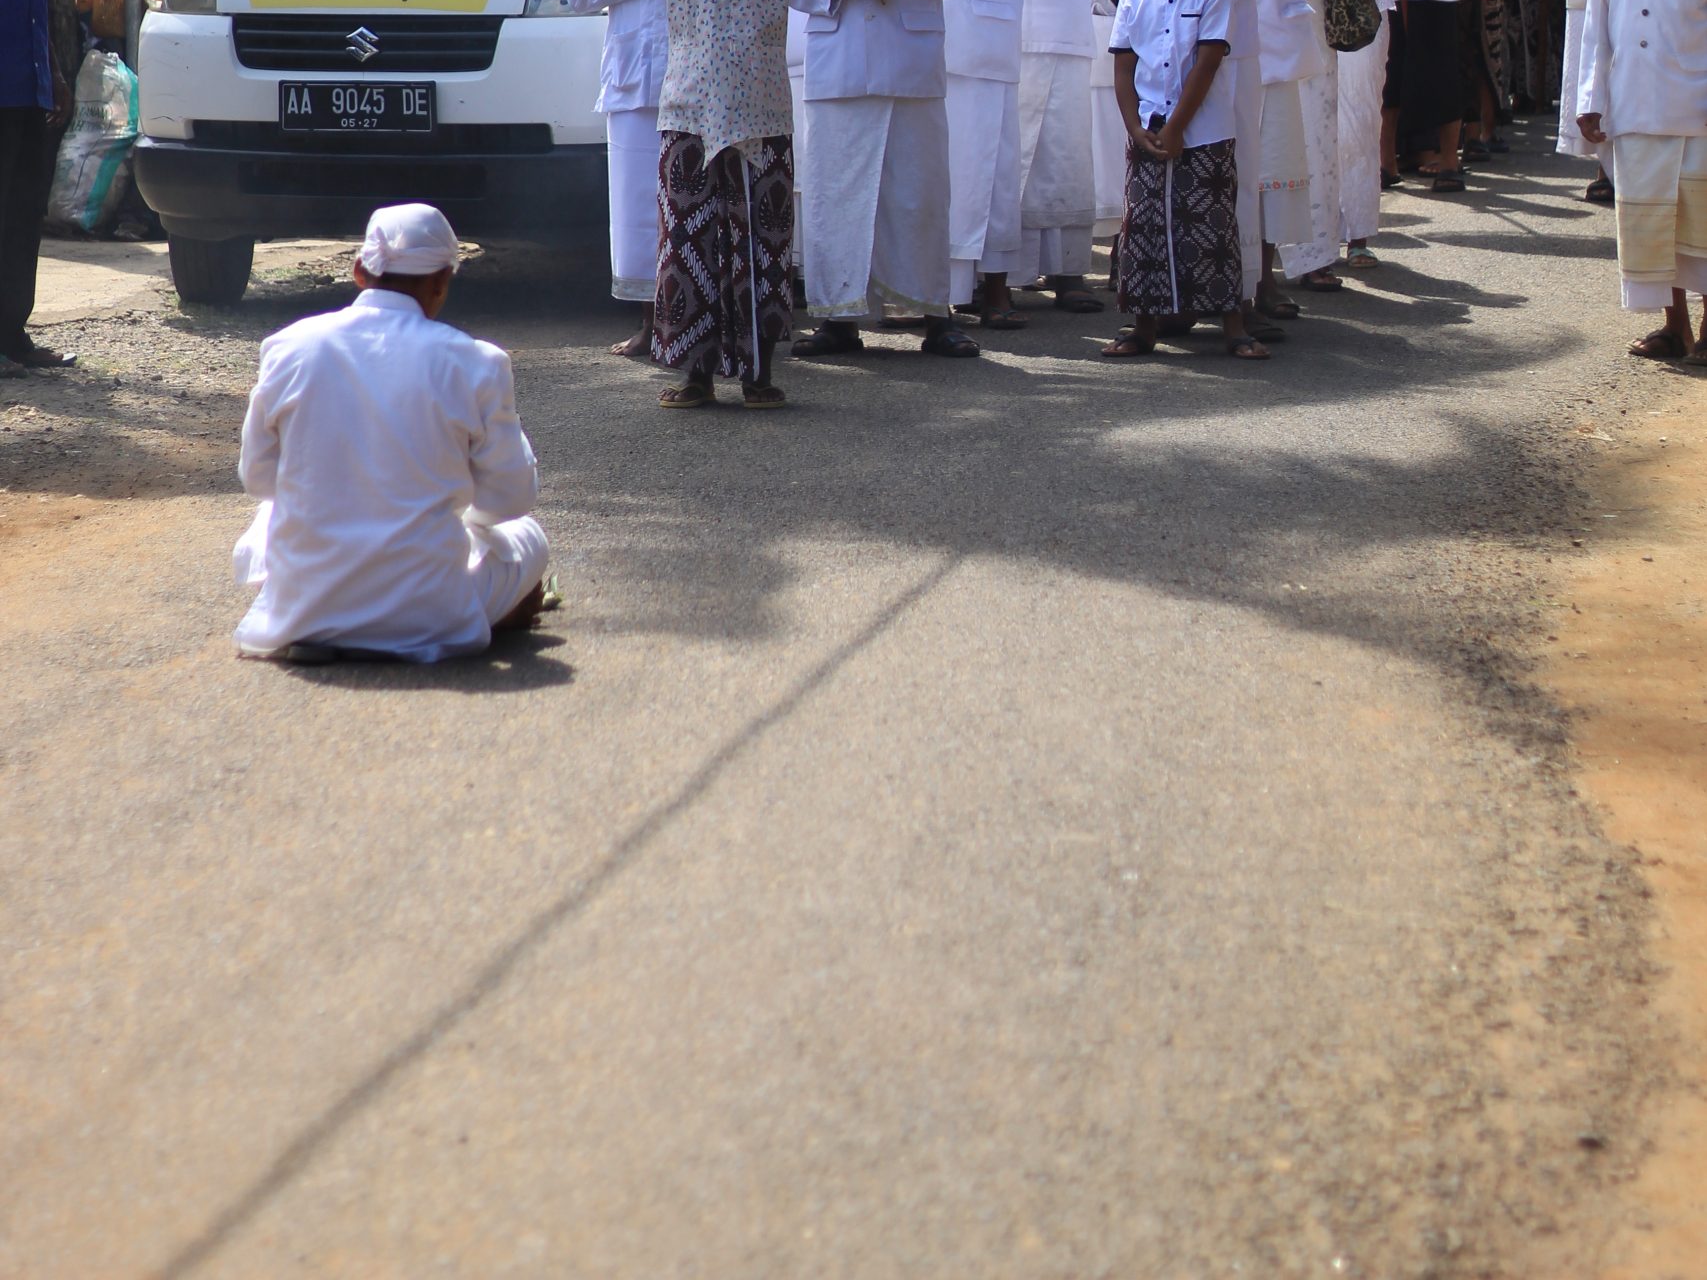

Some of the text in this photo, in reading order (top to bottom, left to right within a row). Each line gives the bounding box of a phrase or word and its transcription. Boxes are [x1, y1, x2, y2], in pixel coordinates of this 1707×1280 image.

[287, 88, 427, 115] AA 9045 DE
